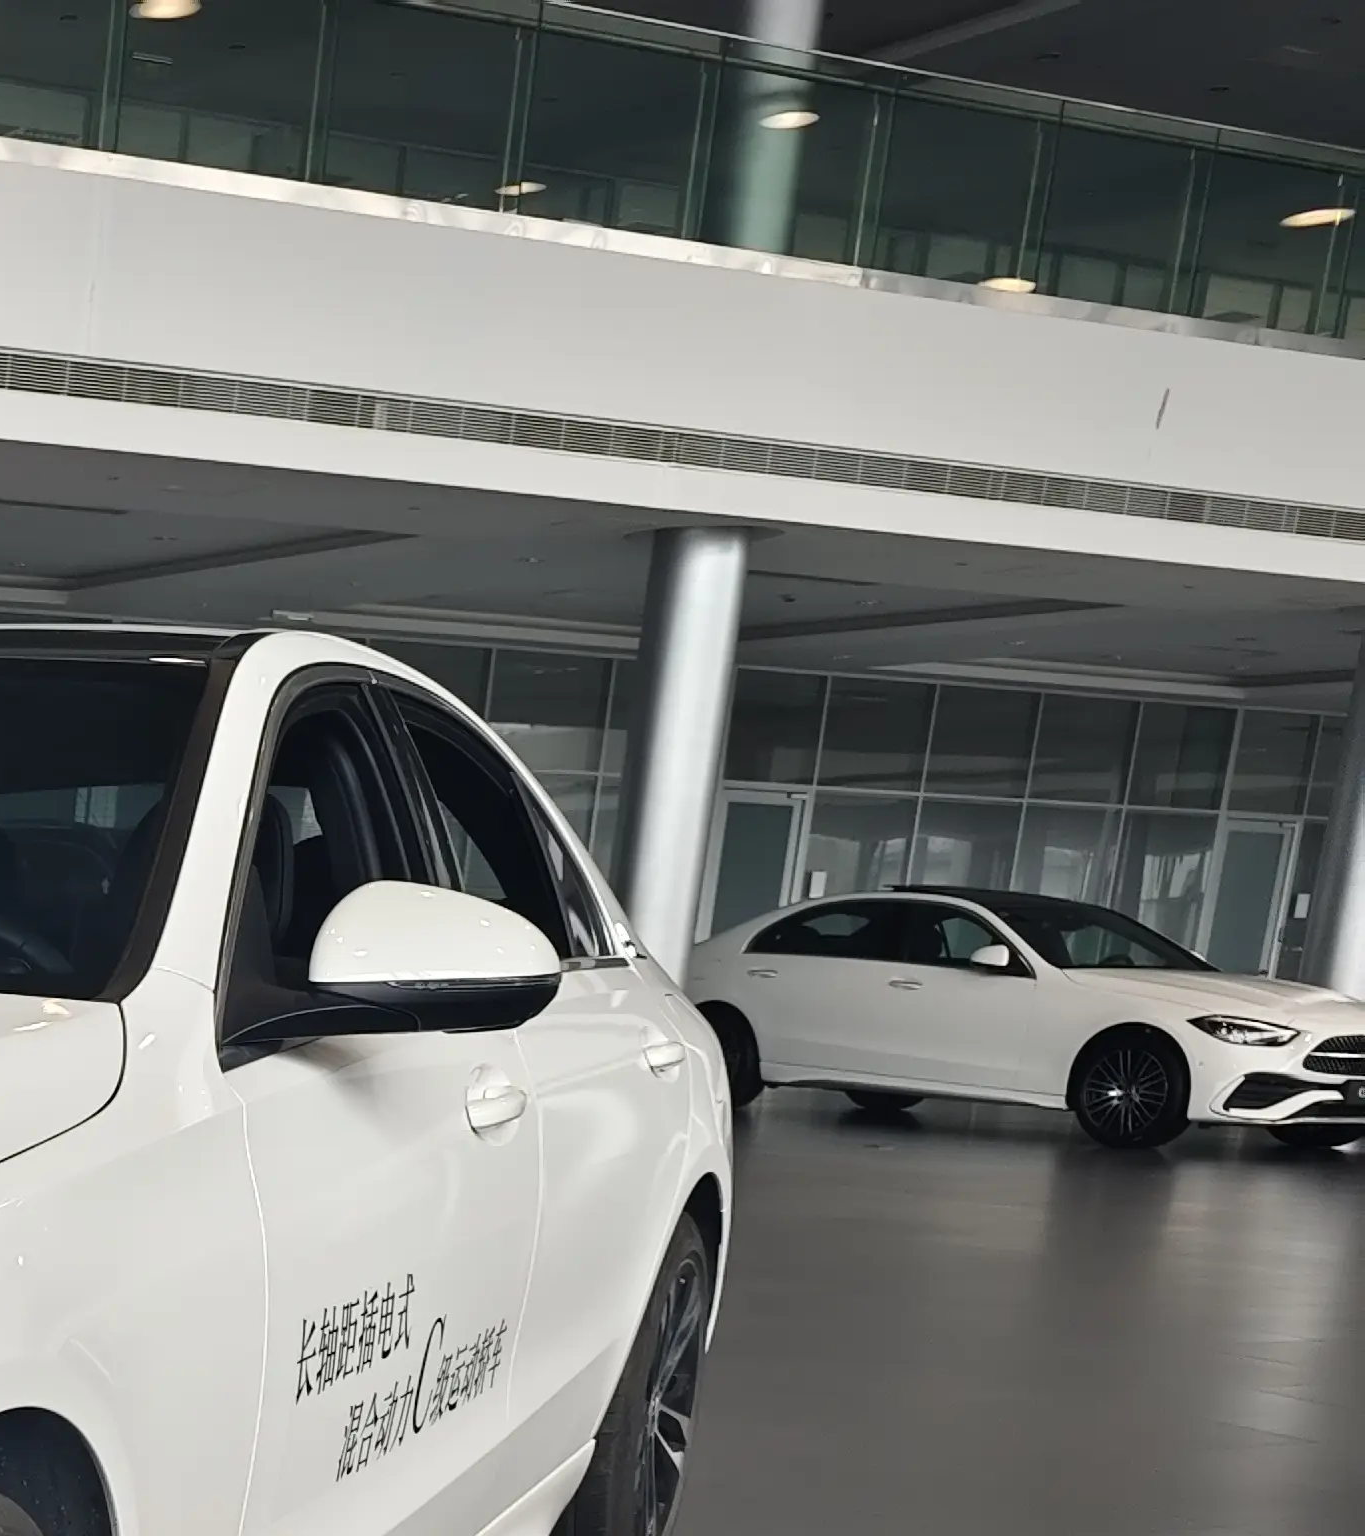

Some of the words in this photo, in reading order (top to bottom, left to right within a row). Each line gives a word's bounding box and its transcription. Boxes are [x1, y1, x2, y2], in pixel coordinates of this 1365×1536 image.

[296, 1273, 415, 1406] 长轴距插电式
